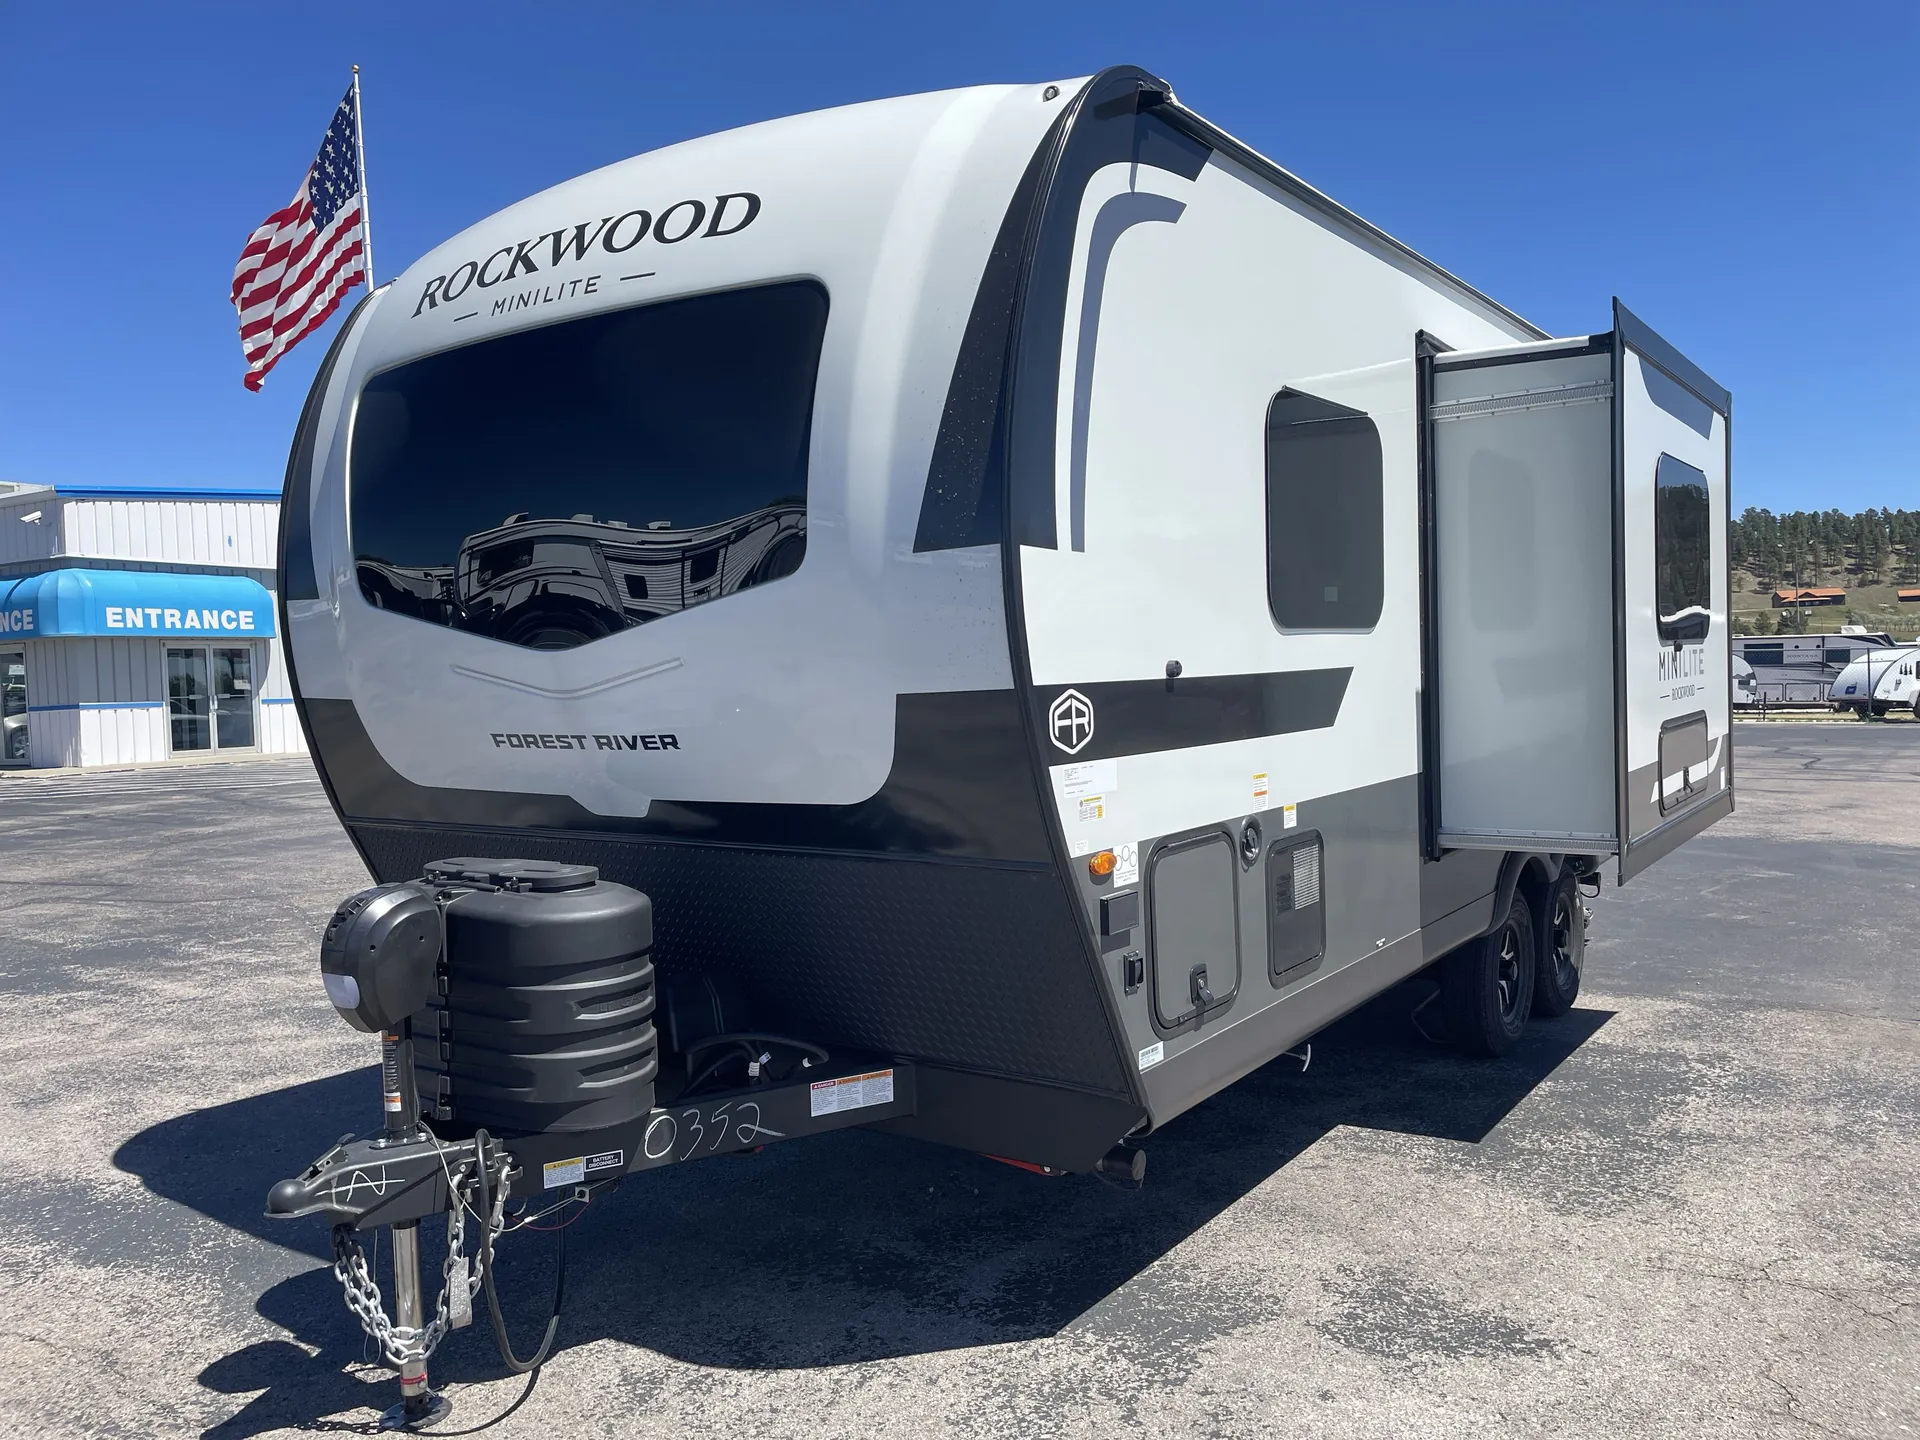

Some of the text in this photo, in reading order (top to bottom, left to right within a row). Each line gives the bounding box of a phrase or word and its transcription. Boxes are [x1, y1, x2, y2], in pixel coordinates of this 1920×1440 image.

[411, 191, 762, 319] ROCKWOOD
[491, 275, 602, 317] MINILITE
[105, 607, 255, 630] ENTRANCE
[1658, 648, 1704, 682] MINILITE
[1671, 684, 1695, 701] ROCKWOOD
[490, 733, 682, 751] FOREST RIVER
[643, 1102, 786, 1162] 0352
[588, 1158, 619, 1168] DISCONNECT
[592, 1155, 615, 1163] BATTERY
